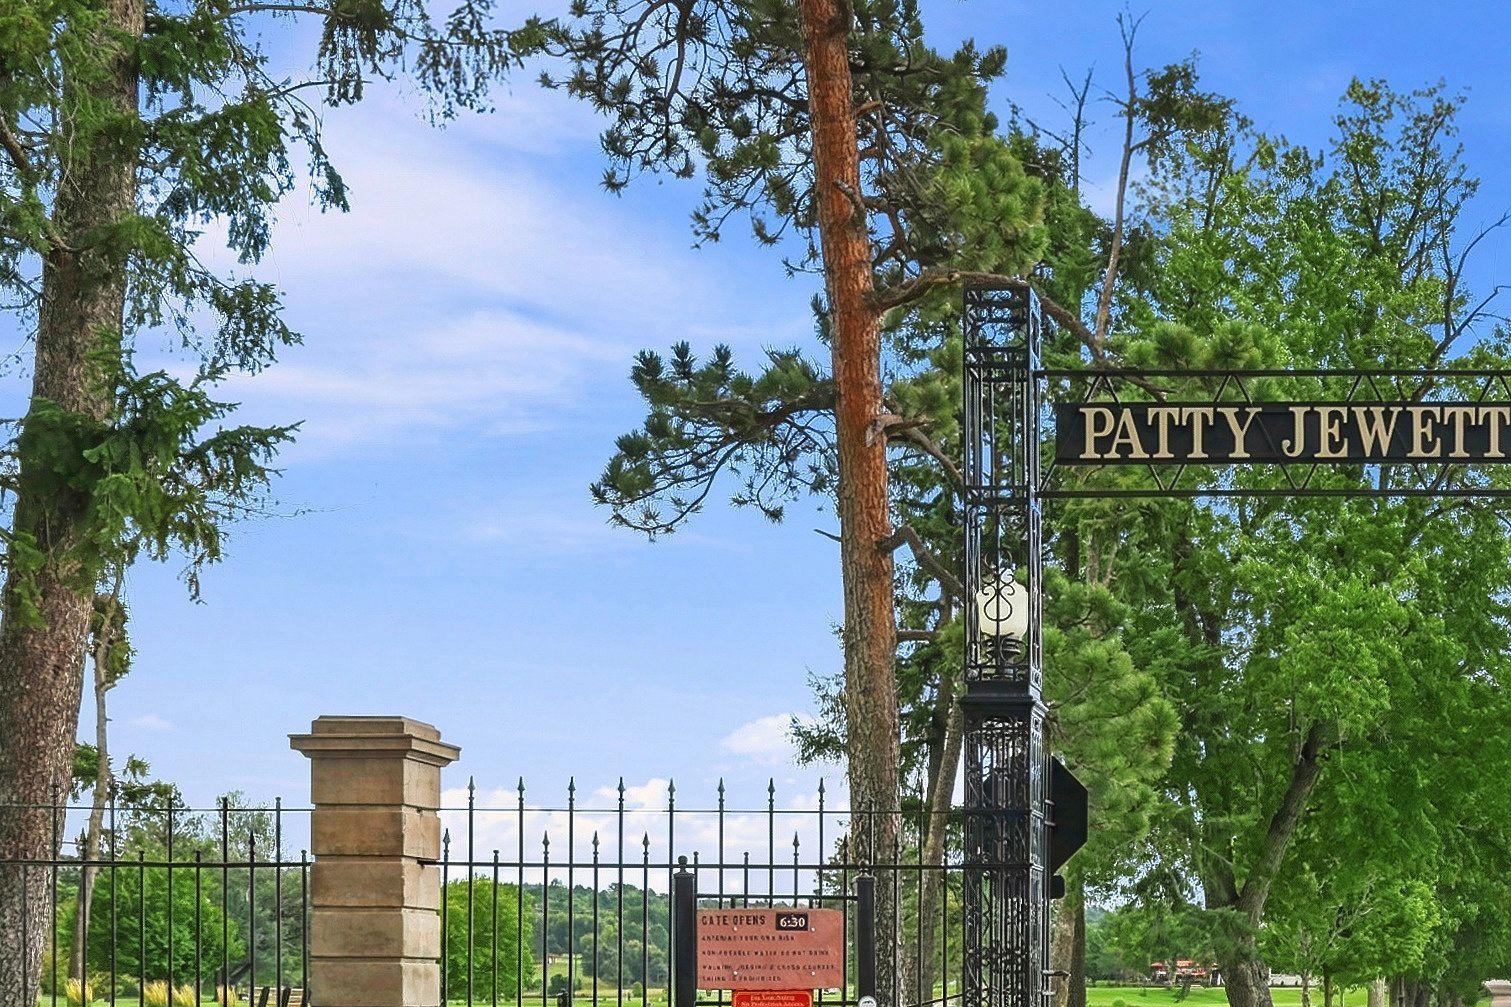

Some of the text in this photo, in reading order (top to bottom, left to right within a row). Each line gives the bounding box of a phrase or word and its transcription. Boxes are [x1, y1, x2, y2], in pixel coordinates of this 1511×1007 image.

[1079, 406, 1262, 459] PATTY
[1281, 406, 1511, 459] JEWETT
[701, 915, 806, 928] GATE OPENS 6:30
